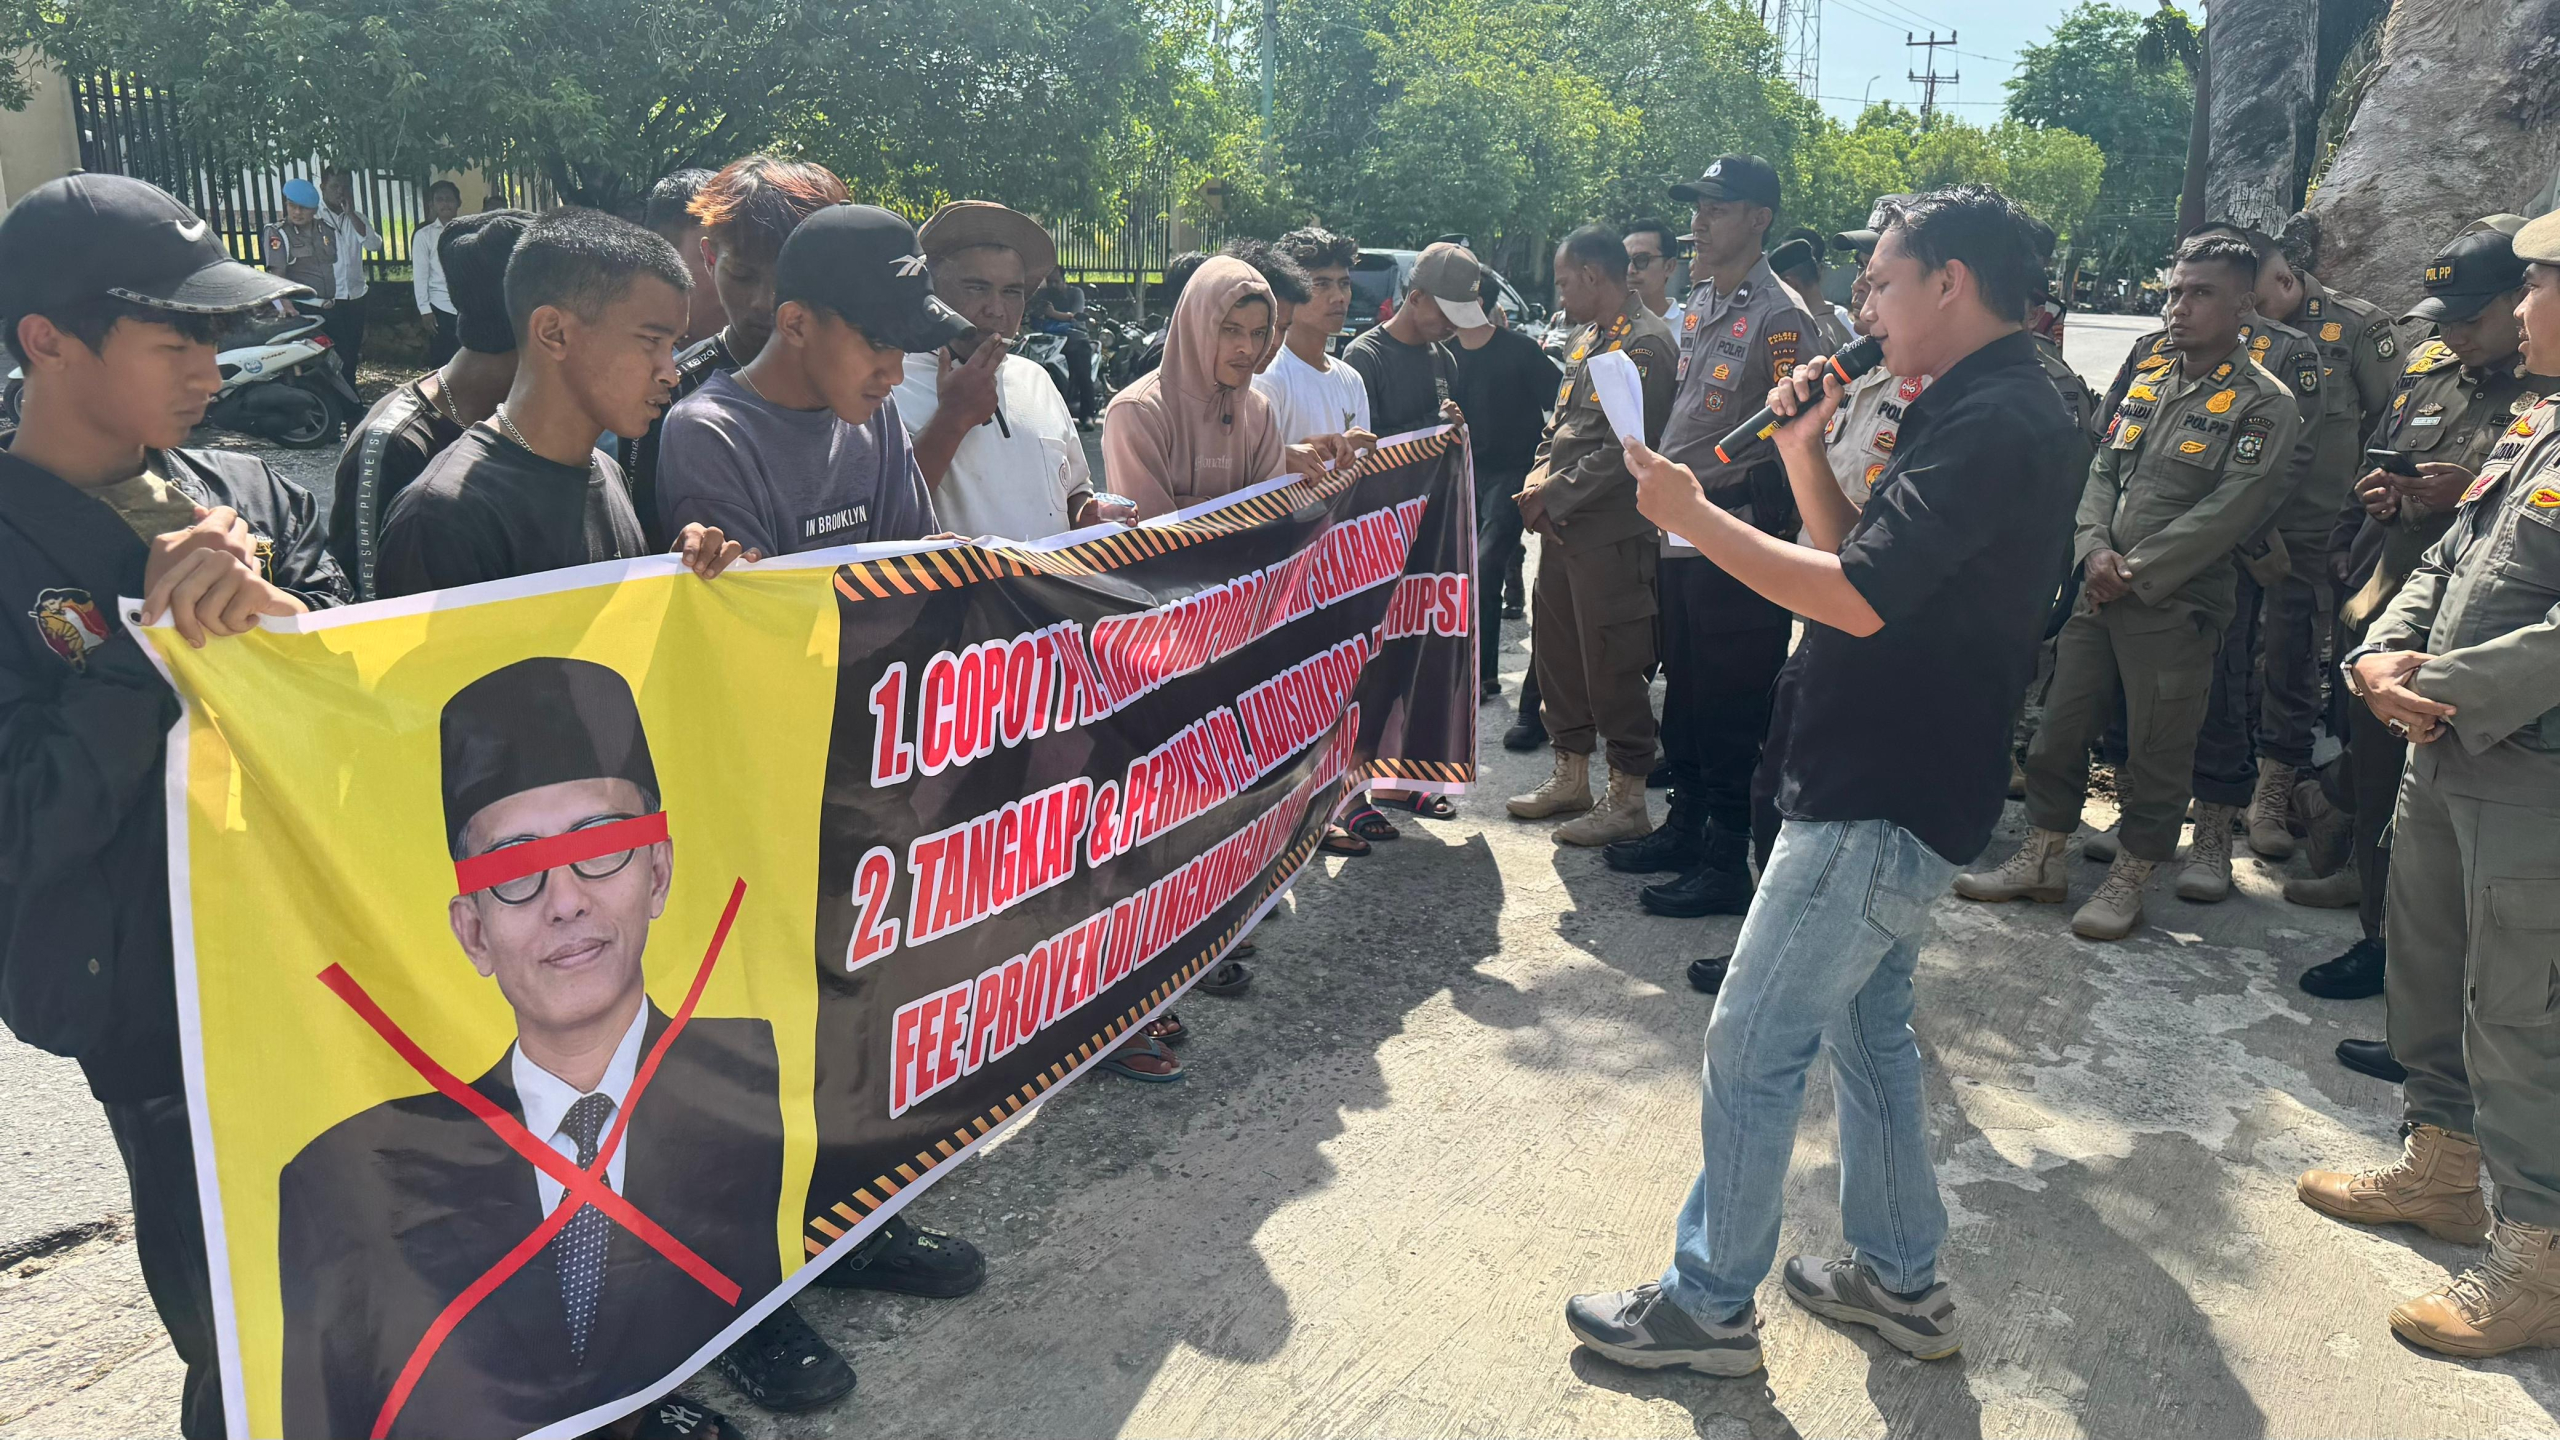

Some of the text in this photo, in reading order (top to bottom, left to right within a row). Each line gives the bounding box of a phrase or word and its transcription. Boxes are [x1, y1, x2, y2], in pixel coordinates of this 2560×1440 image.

[2425, 265, 2452, 282] POL PP
[1768, 331, 1798, 342] POLRES
[1717, 340, 1746, 359] POLRI
[1772, 348, 1796, 356] RIAU
[1878, 400, 1903, 421] POL
[2184, 412, 2207, 432] POL
[2208, 420, 2230, 436] PP
[805, 504, 868, 538] IN BROOKLYN
[870, 664, 913, 786] 1.
[918, 630, 1057, 773] COPOT
[1311, 509, 1405, 606] SEKARANG
[847, 848, 900, 970] 2.
[907, 778, 1092, 945] TANGKAP
[1087, 781, 1120, 867] &
[1116, 720, 1227, 854] PERIKSA
[1207, 707, 1258, 798] Plt.
[1367, 573, 1469, 662] RUPSI
[891, 981, 972, 1117] FEE
[964, 909, 1110, 1074] PROYEK
[1100, 889, 1145, 993] DI
[1134, 804, 1279, 969] LINGKUNGAN
